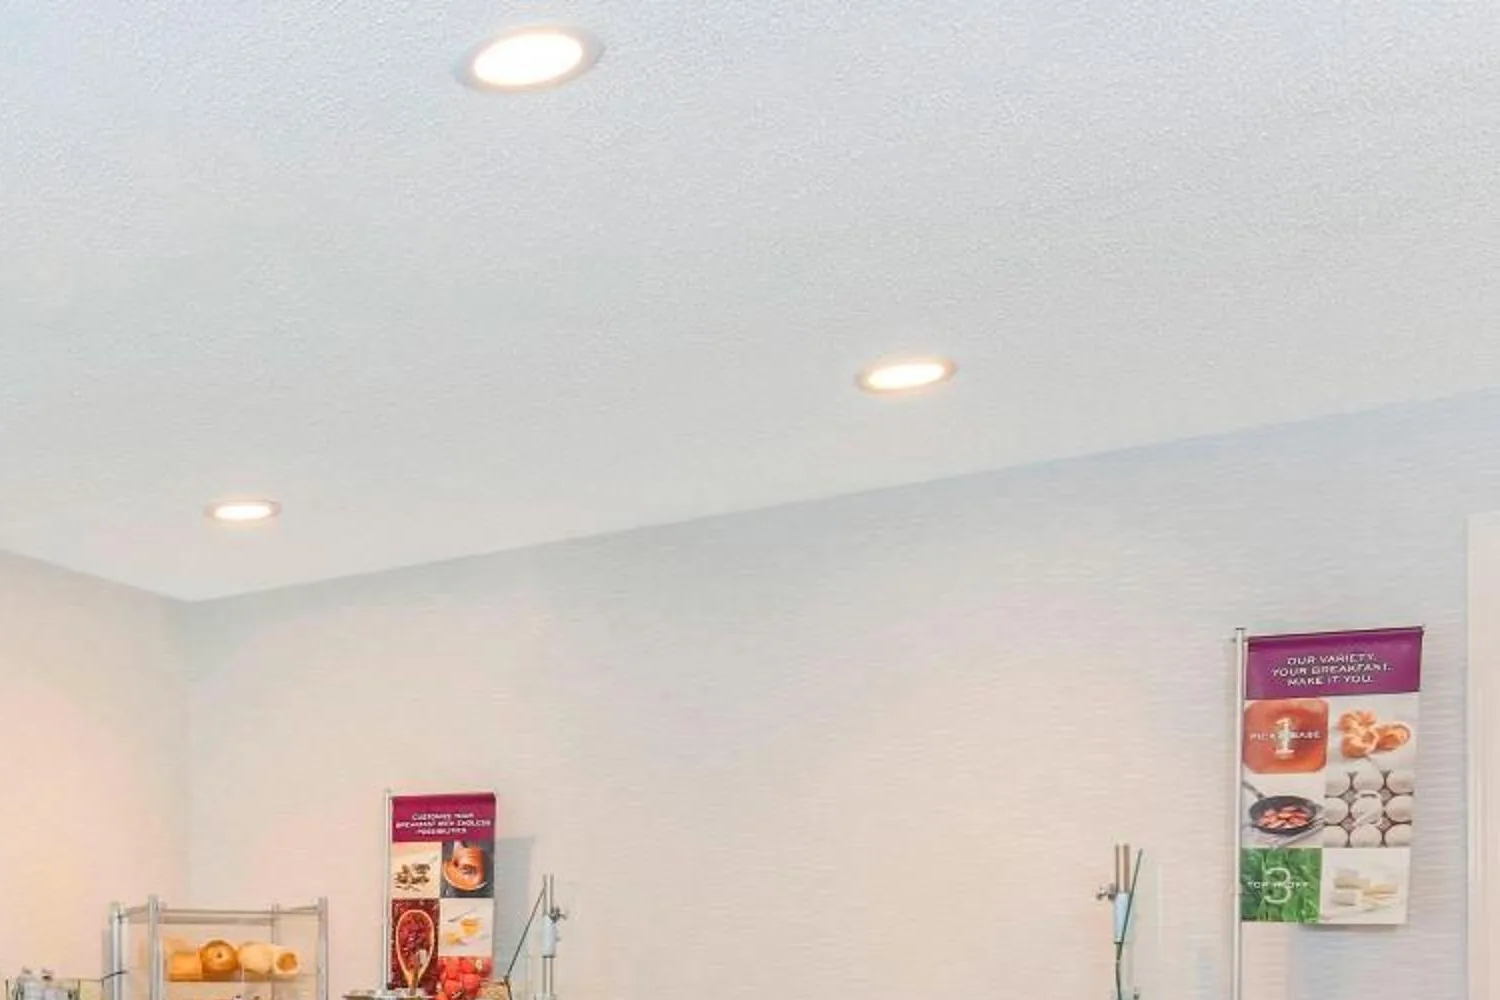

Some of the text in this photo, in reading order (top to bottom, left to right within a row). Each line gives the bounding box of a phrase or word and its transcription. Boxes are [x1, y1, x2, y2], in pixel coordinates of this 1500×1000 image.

[1287, 655, 1315, 665] OUR
[1272, 667, 1307, 677] YOUR
[1287, 677, 1323, 686] MAKE
[1263, 867, 1292, 904] 3
